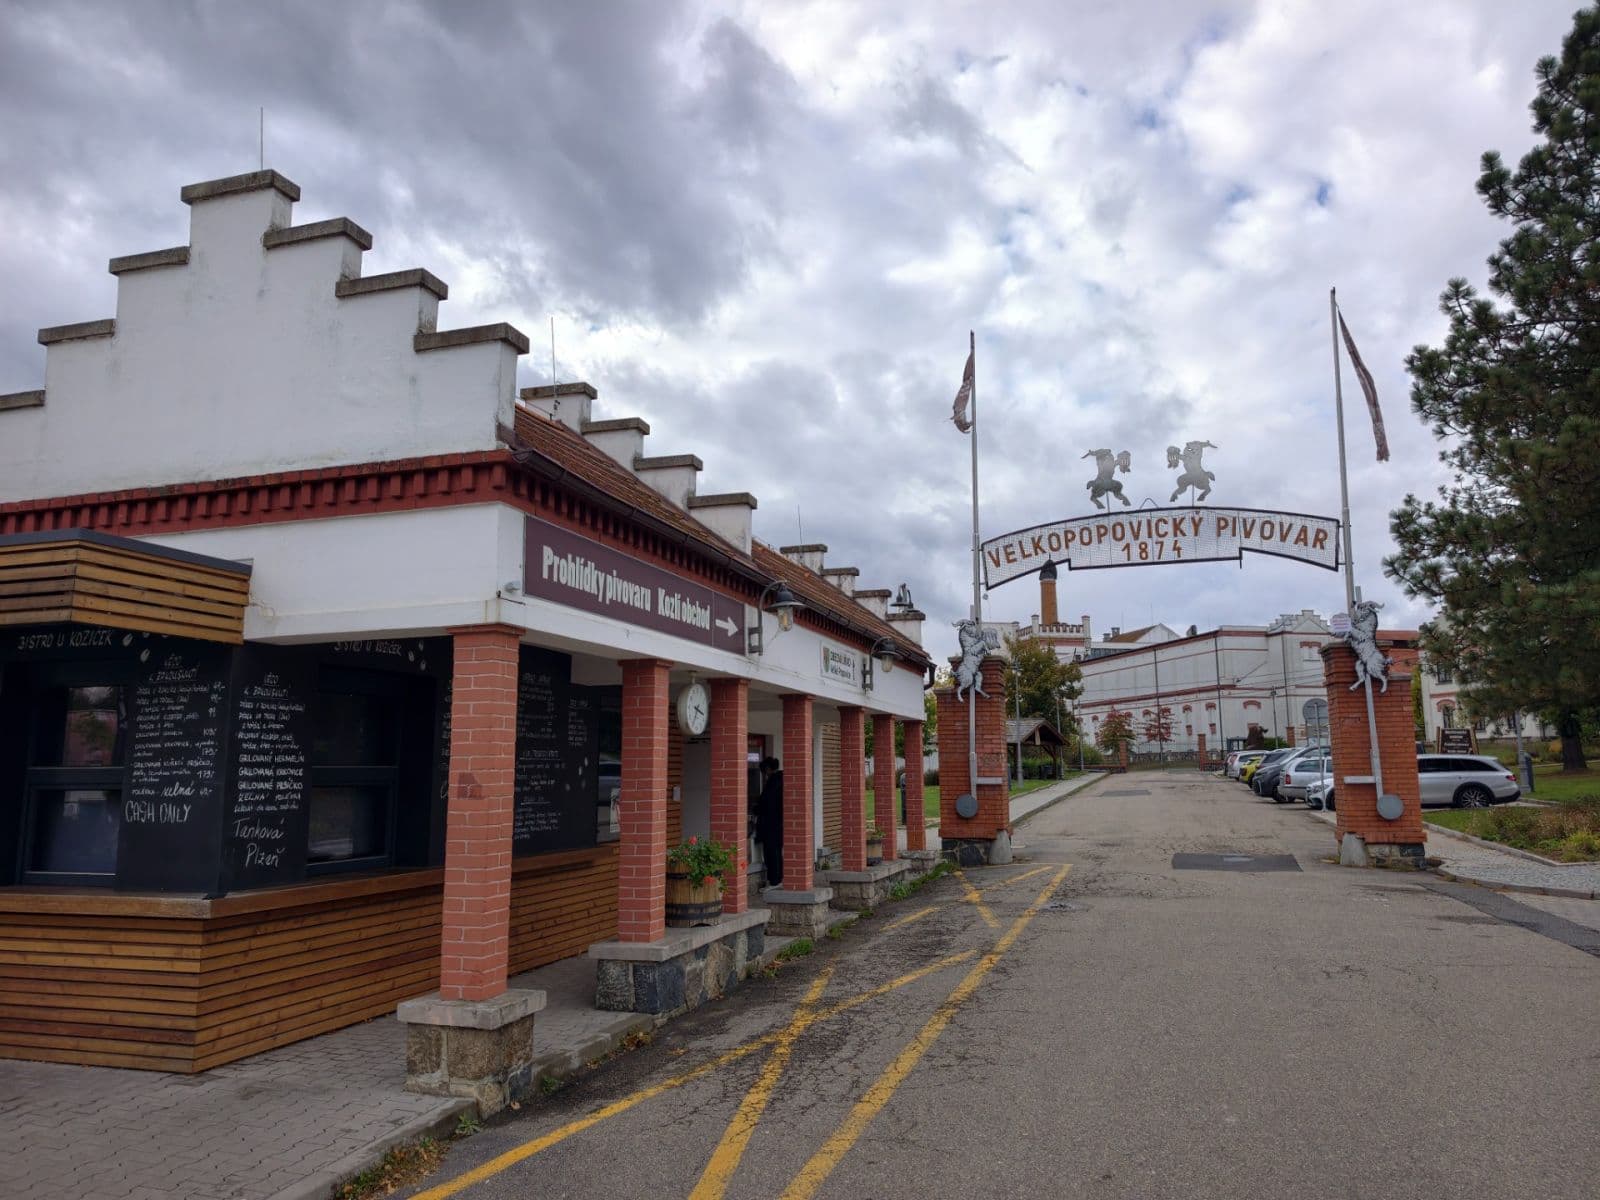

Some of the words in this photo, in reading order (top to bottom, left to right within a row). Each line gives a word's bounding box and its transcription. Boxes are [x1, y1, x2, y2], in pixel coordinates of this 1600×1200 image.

[987, 510, 1203, 568] VELKOPOPOVICKÝ
[1216, 516, 1328, 550] PIVOVAR
[1121, 539, 1183, 562] 1874
[542, 545, 605, 602] Prohlídky
[606, 569, 651, 612] pivovaru
[658, 587, 681, 621] Kozlí
[681, 597, 711, 631] obchod
[125, 800, 155, 823] CASH
[160, 803, 192, 823] ONLY
[232, 817, 285, 840] Tanková
[245, 842, 286, 868] Plzeň
